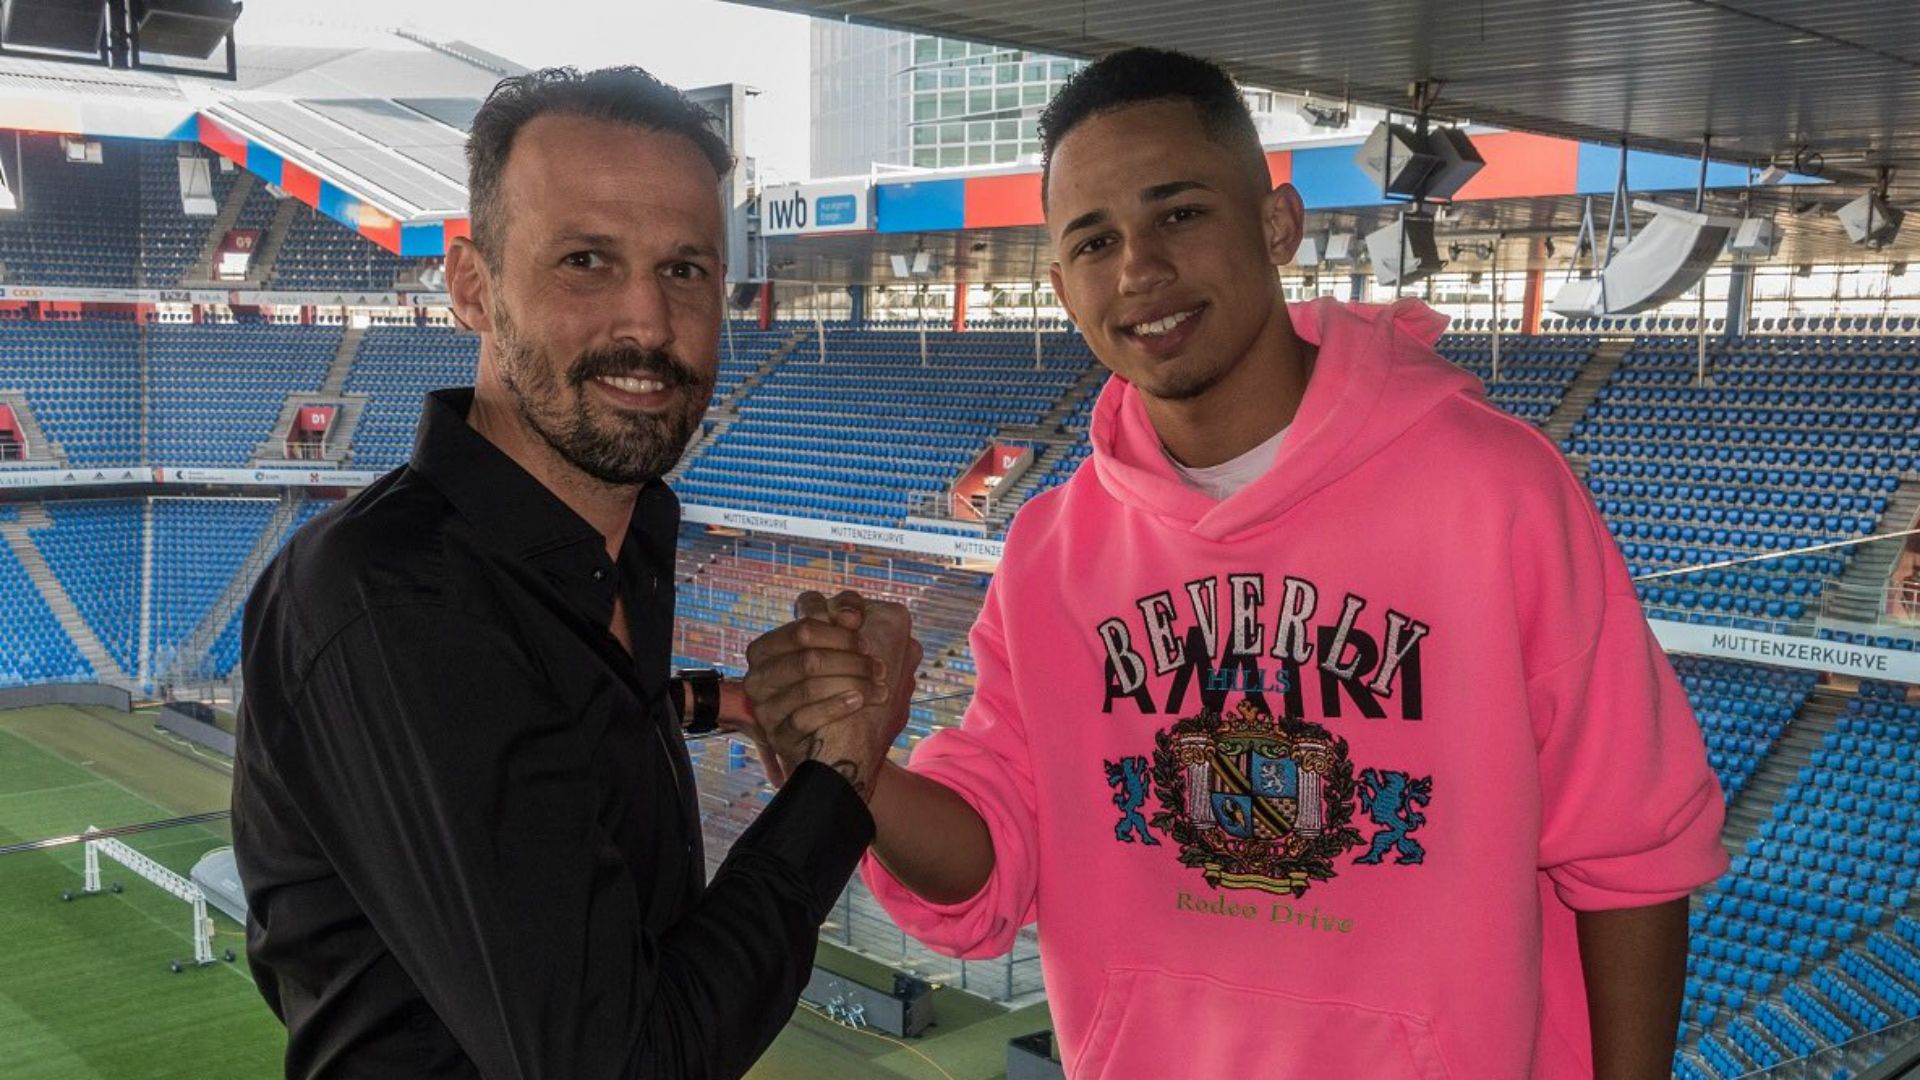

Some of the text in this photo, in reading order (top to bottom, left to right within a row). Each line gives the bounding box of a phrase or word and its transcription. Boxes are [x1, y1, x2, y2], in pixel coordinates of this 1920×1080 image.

[723, 512, 788, 530] MUTTENZERKURVE
[831, 527, 905, 545] MUTTENZERKURVE
[1097, 573, 1430, 698] BEVERLY
[1712, 633, 1888, 671] MUTTENZERKURVE
[1206, 667, 1292, 693] HILLS
[1177, 892, 1354, 933] Rodeo Drive
